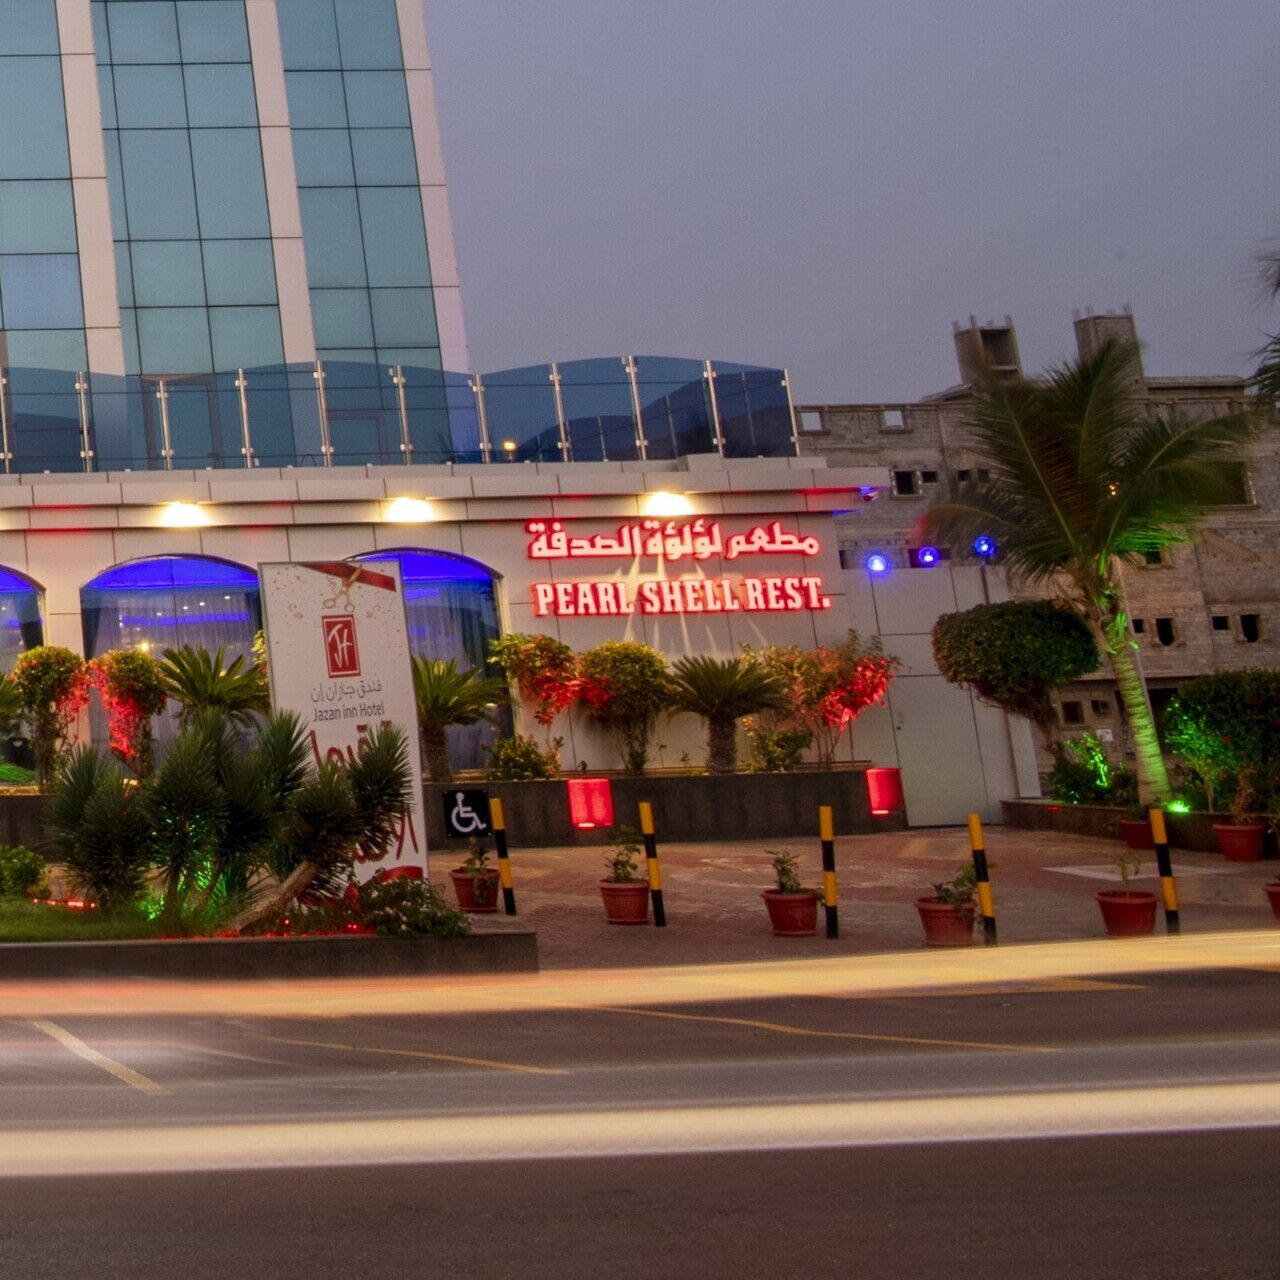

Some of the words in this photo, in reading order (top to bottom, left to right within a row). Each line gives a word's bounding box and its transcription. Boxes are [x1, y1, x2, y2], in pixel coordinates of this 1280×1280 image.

[526, 520, 641, 560] الصدفة
[641, 518, 723, 561] لؤلؤة
[724, 521, 822, 561] مطعم
[532, 581, 635, 618] PEARL
[639, 578, 740, 614] SHELL
[742, 576, 832, 611] REST.
[325, 681, 356, 701] جازان
[356, 680, 383, 699] فندق
[313, 707, 341, 722] Jazan
[342, 703, 359, 719] inn
[359, 700, 385, 717] Hotel
